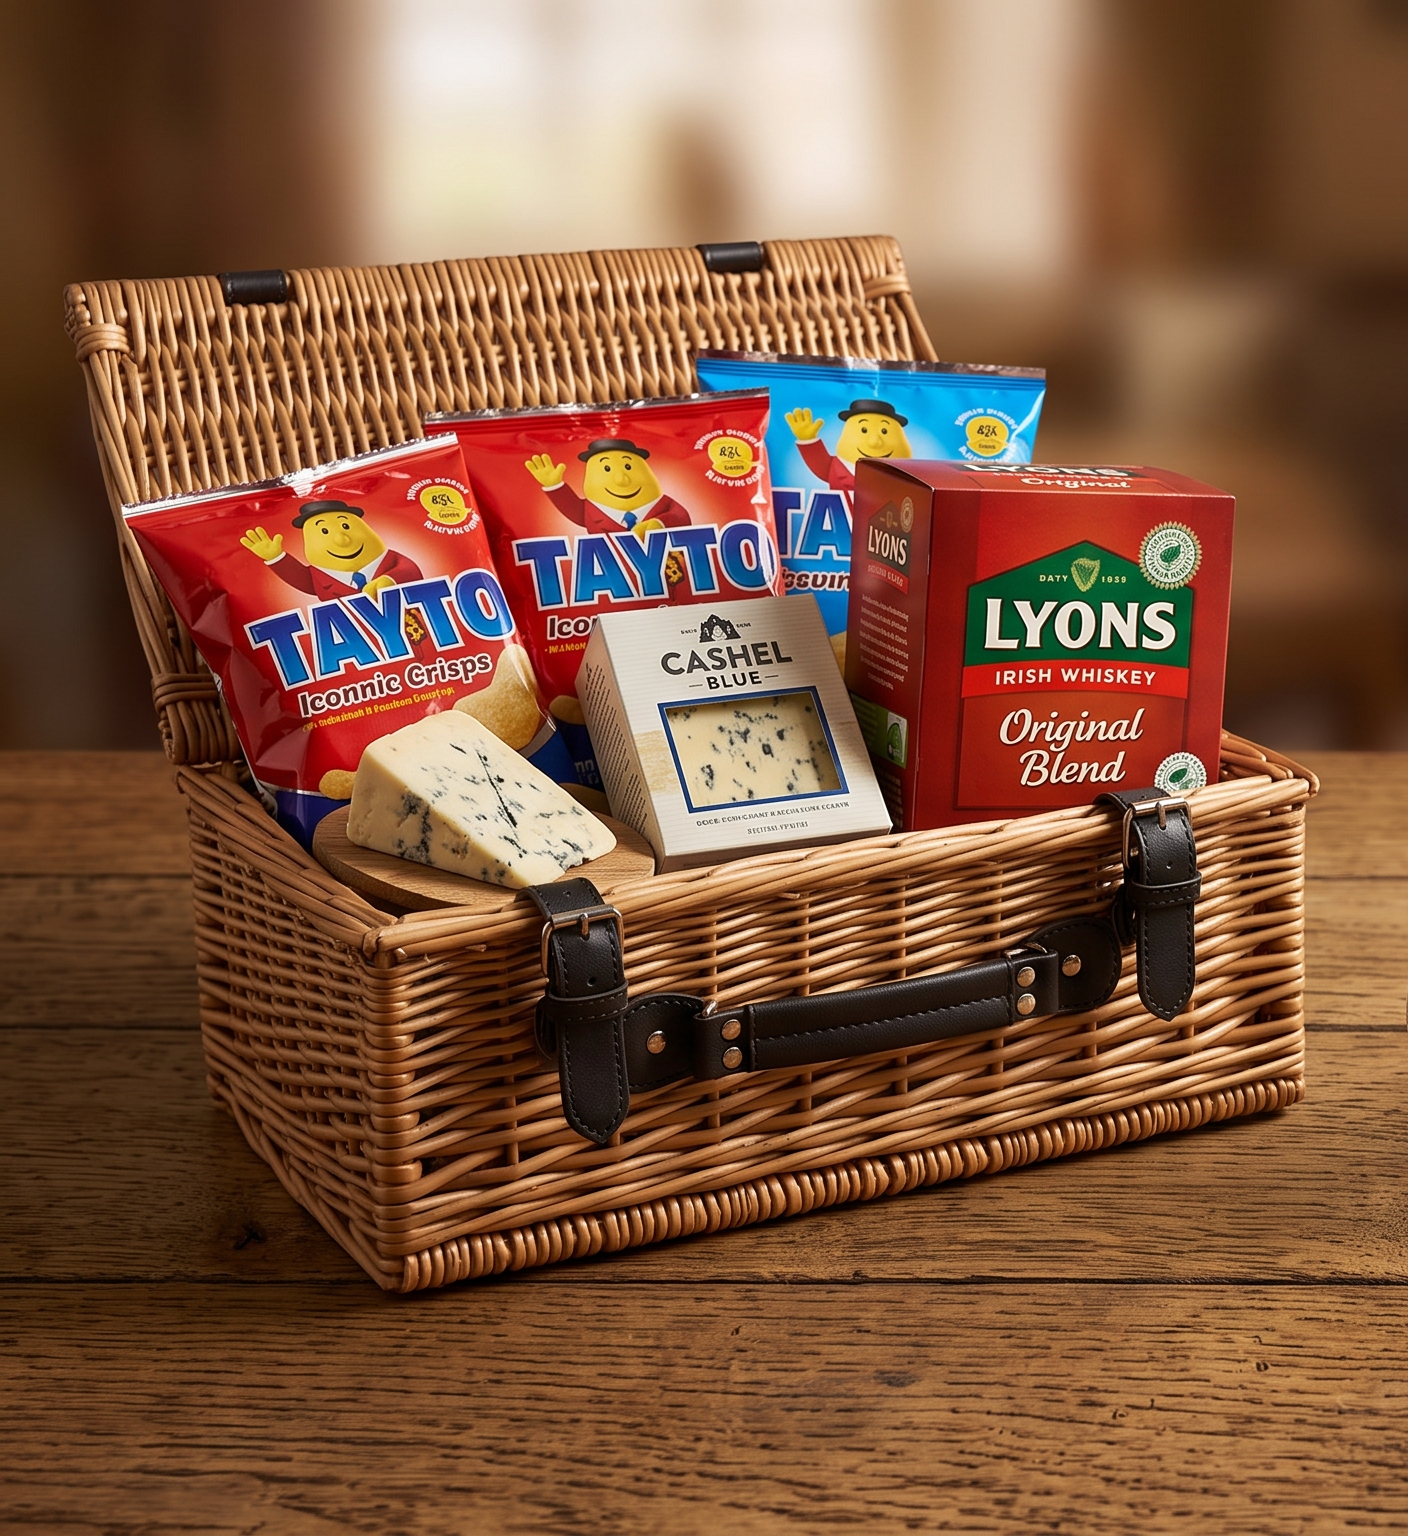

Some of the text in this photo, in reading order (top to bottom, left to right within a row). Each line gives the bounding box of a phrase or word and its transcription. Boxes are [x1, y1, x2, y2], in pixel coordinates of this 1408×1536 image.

[1020, 477, 1131, 488] Original
[772, 487, 854, 561] TA
[512, 519, 778, 610] TAYTO
[868, 525, 907, 566] LYONS
[1039, 574, 1068, 582] DATY
[244, 567, 516, 690] TAYTO
[547, 615, 597, 640] Ico
[984, 598, 1177, 651] LYONS
[660, 641, 793, 676] CASHEL
[995, 667, 1156, 686] IRISH WHISKEY
[298, 671, 403, 718] Iconnic
[405, 653, 493, 690] Crisps
[706, 670, 762, 690] BLUE
[998, 706, 1146, 751] Original
[1018, 750, 1126, 787] Blend
